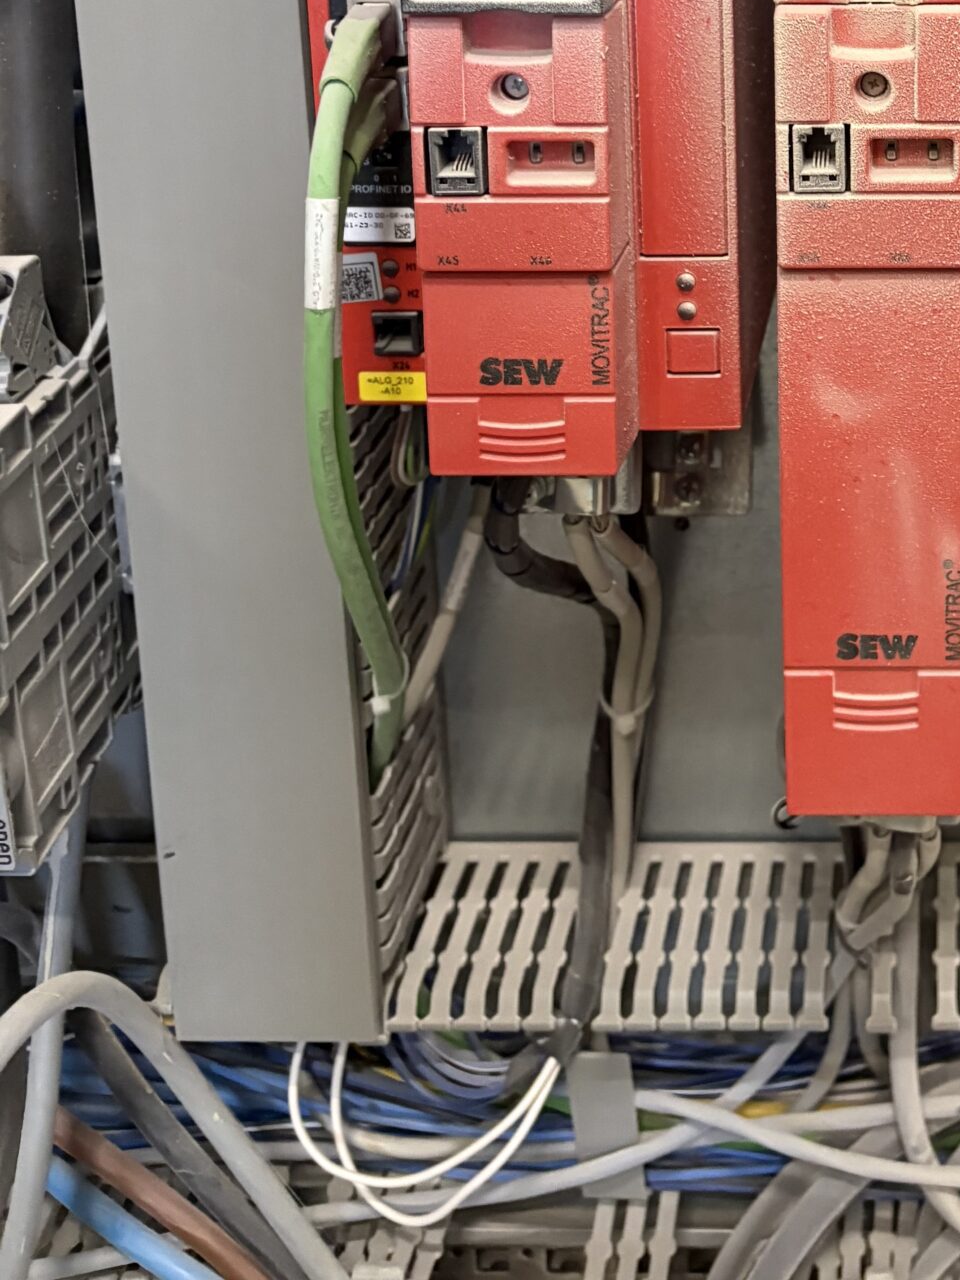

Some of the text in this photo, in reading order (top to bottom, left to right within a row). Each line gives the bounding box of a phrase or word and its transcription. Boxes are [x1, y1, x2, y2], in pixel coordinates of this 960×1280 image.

[401, 184, 412, 194] IO
[437, 255, 459, 266] X45
[530, 255, 552, 266] X46
[479, 357, 565, 386] SEW
[836, 633, 918, 661] SEW
